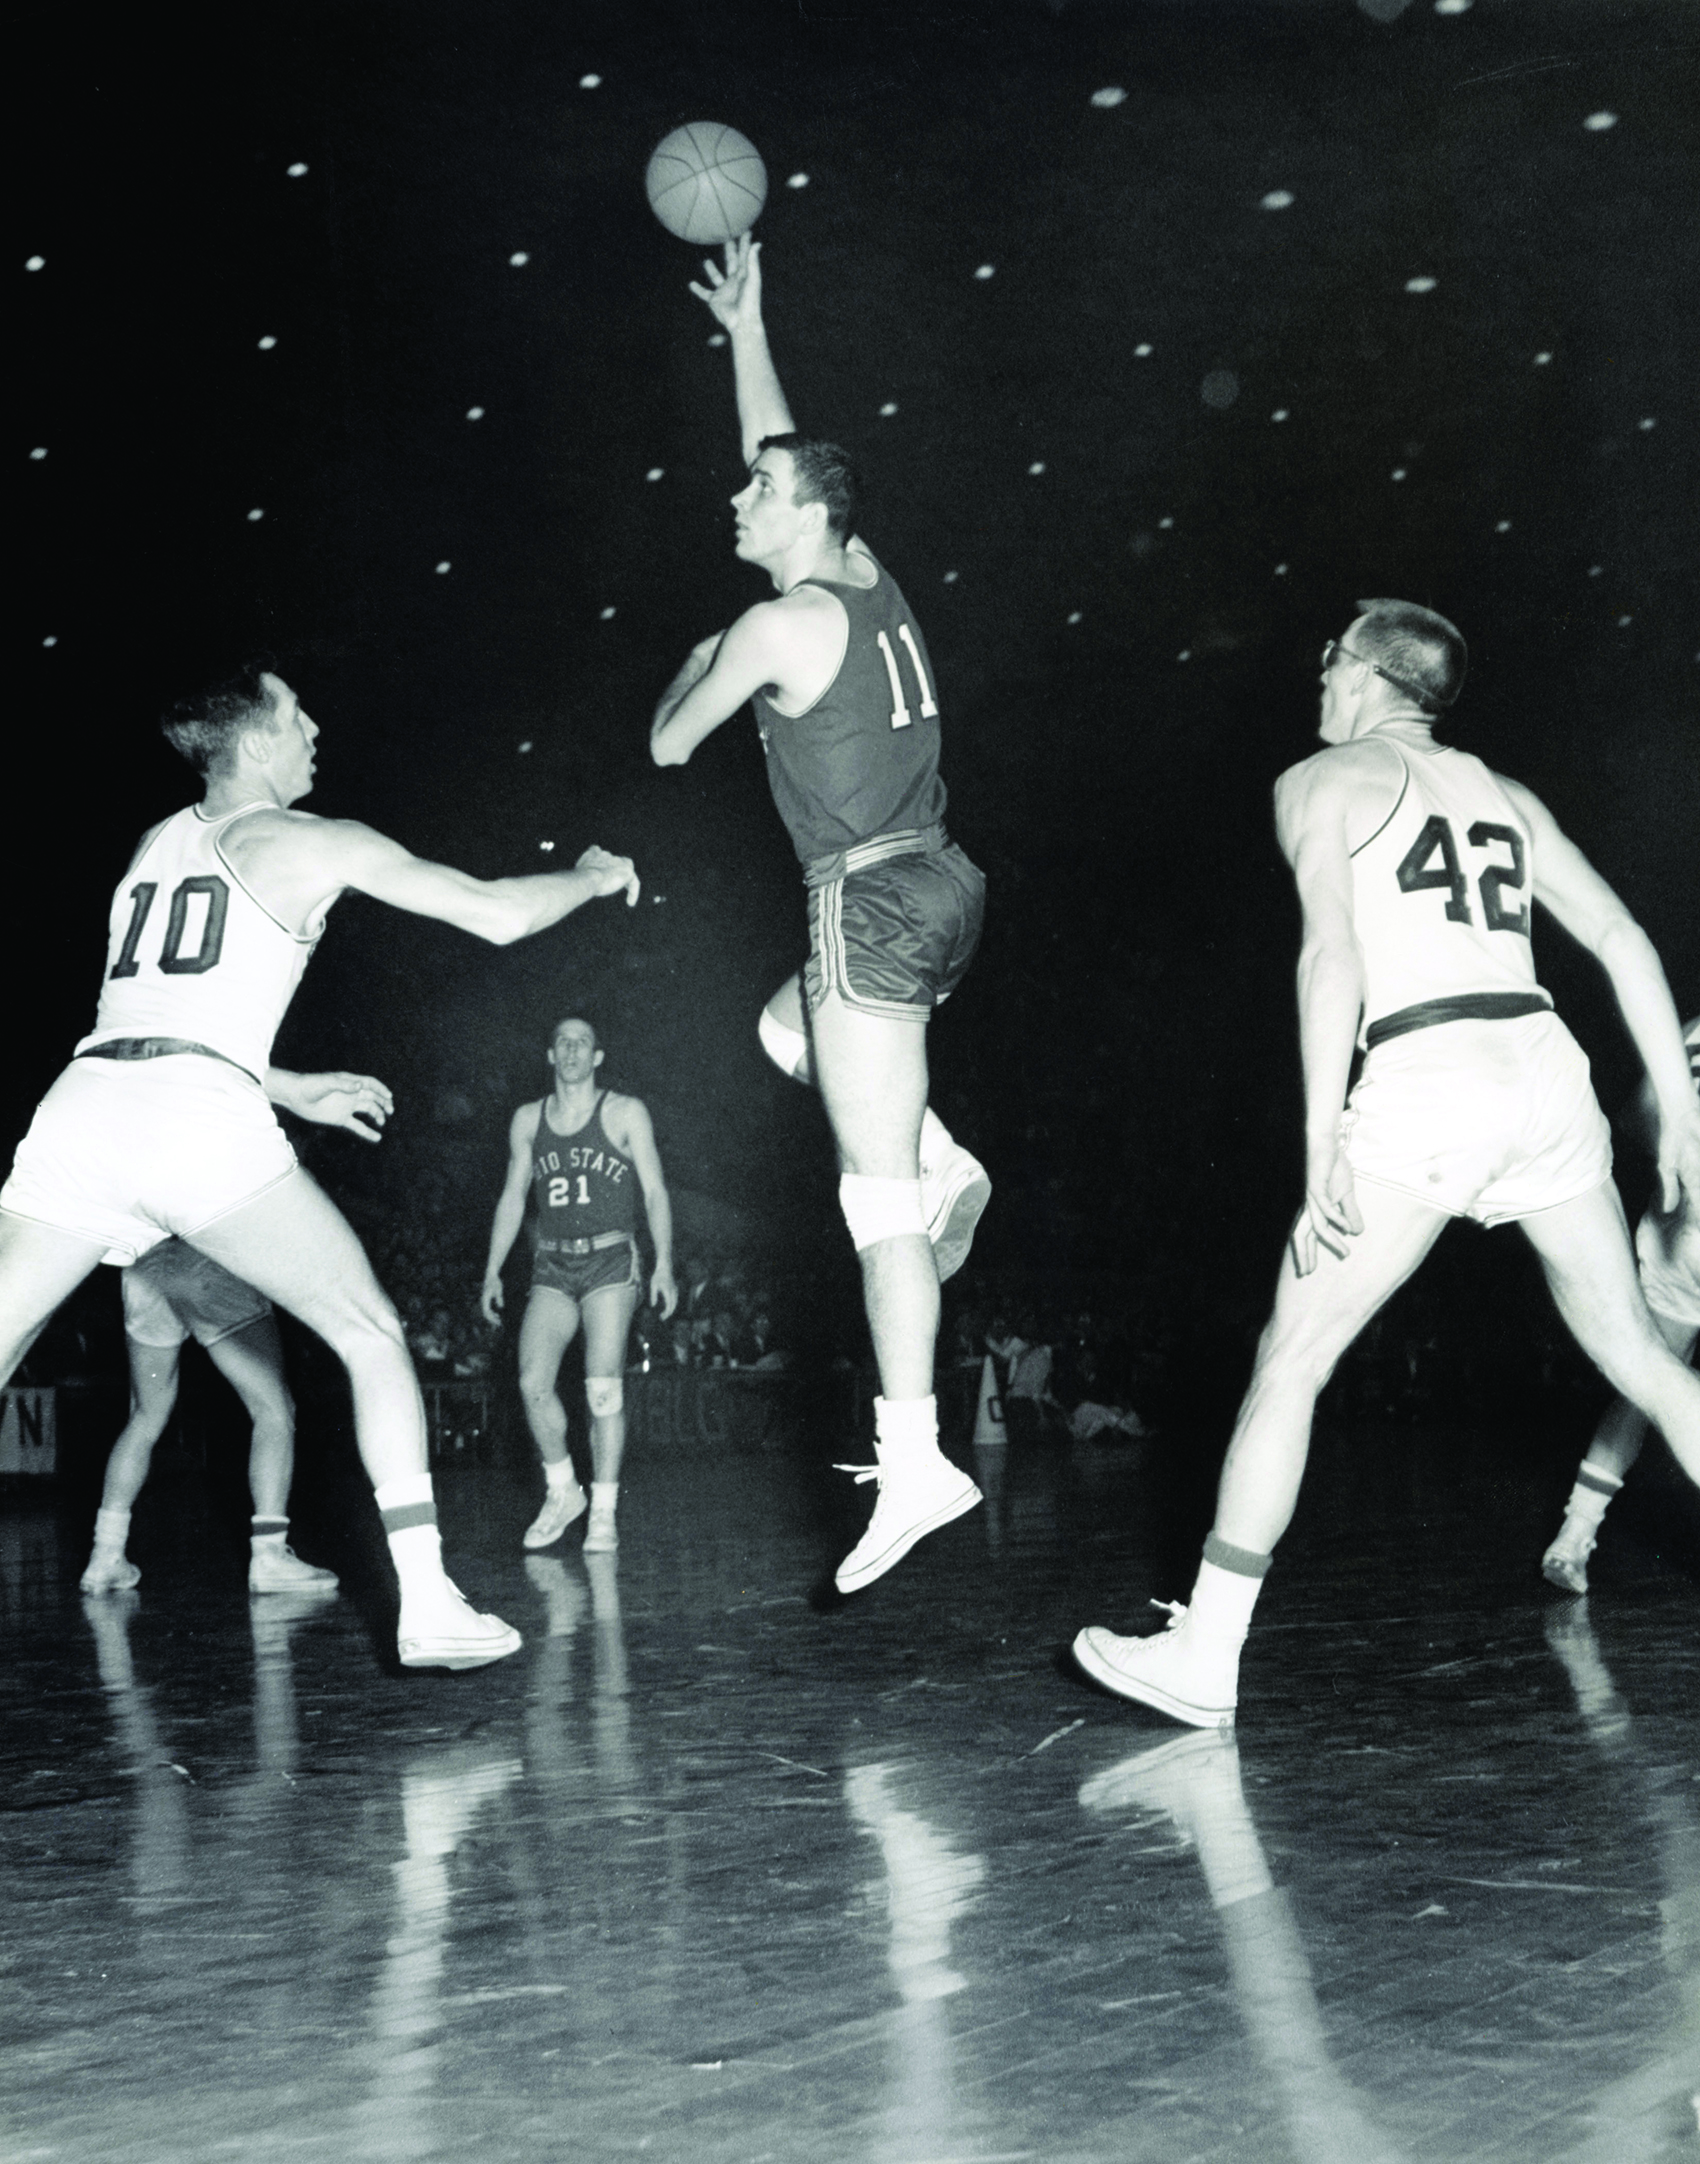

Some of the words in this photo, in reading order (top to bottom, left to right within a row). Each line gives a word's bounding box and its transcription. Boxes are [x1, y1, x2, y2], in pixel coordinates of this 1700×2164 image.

[877, 623, 938, 730] 11
[109, 874, 230, 980] 10
[1396, 814, 1530, 938] 42
[548, 1174, 591, 1207] 21
[570, 1147, 628, 1183] STATE
